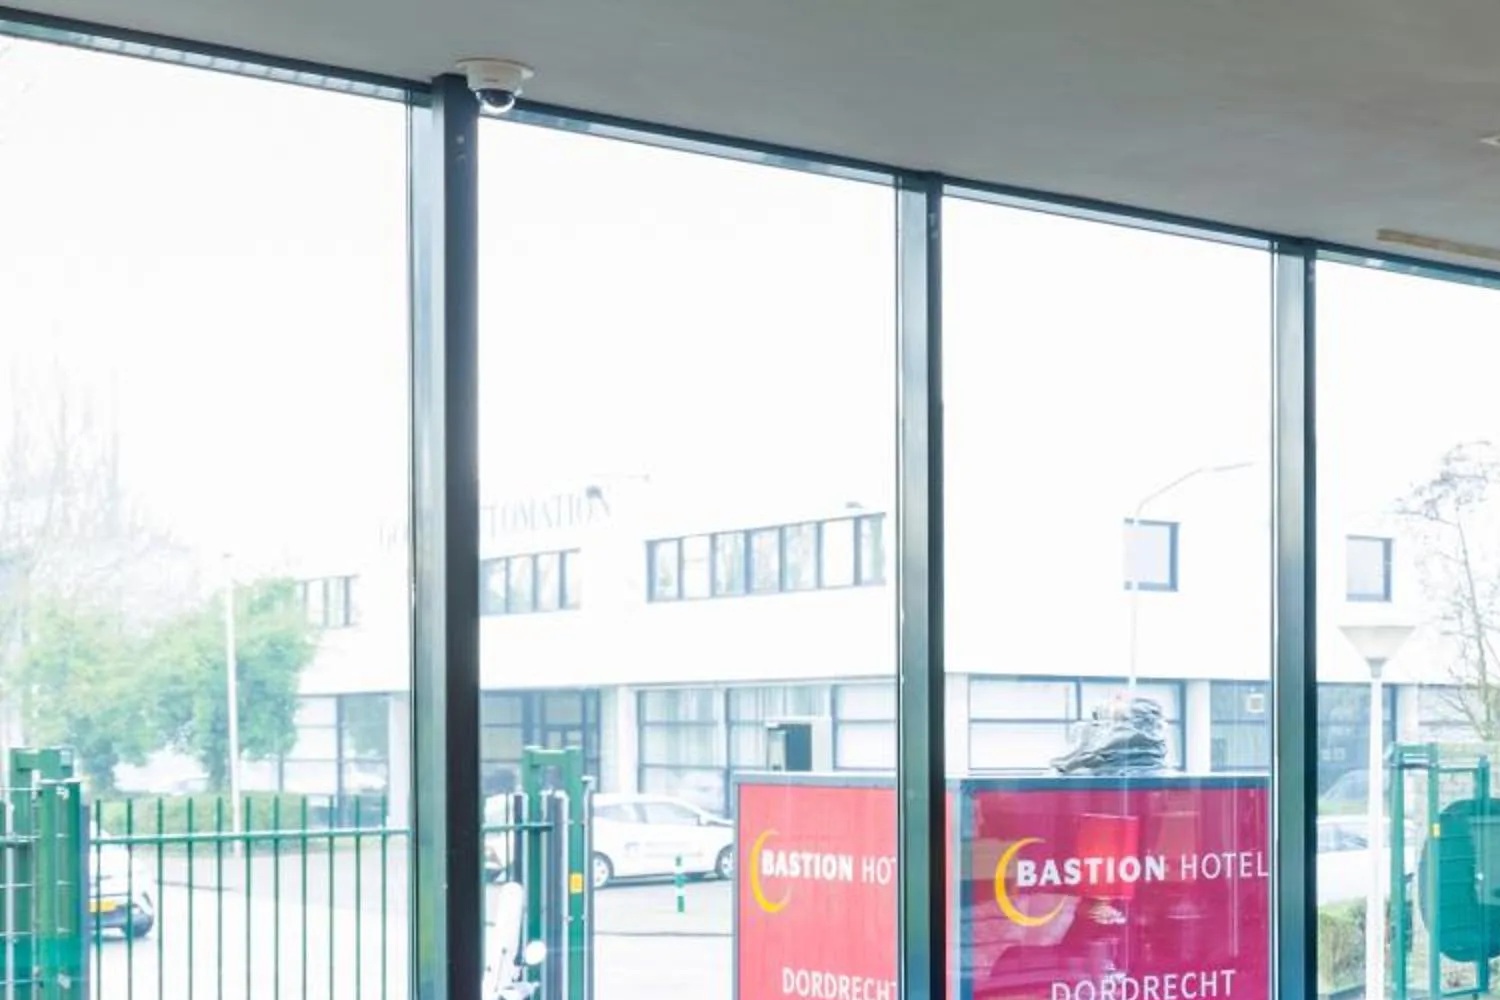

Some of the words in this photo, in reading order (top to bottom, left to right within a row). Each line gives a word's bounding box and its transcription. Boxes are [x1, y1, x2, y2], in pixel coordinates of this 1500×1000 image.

[761, 850, 854, 881] BASTION
[1016, 855, 1166, 887] BASTION
[1181, 851, 1270, 880] HOTEL
